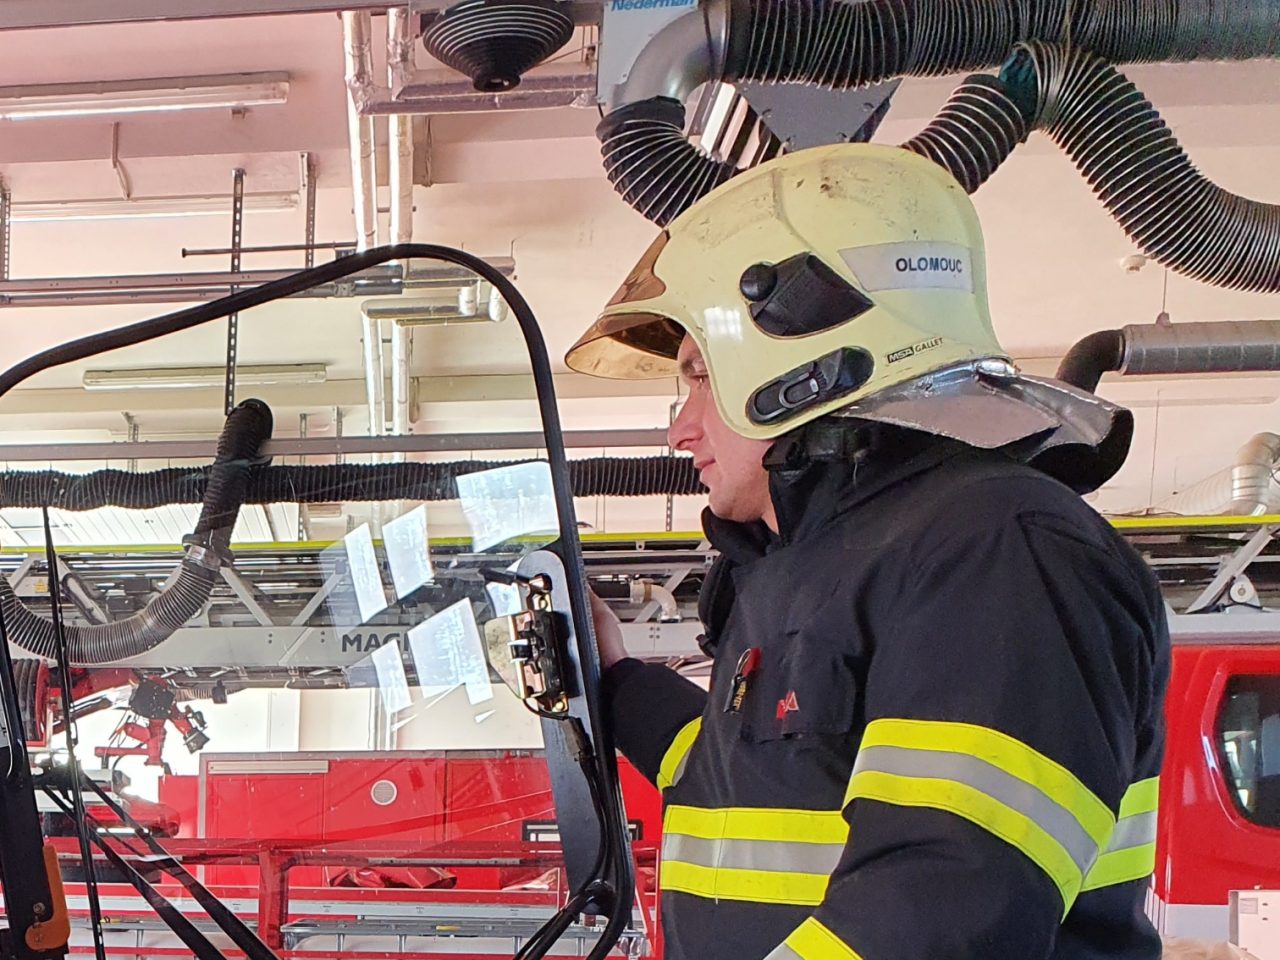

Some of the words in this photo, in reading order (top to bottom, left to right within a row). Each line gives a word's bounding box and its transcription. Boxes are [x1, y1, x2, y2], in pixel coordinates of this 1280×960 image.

[895, 257, 963, 273] OLOMOUC
[915, 337, 943, 352] GALLET
[341, 633, 409, 652] MAGI
